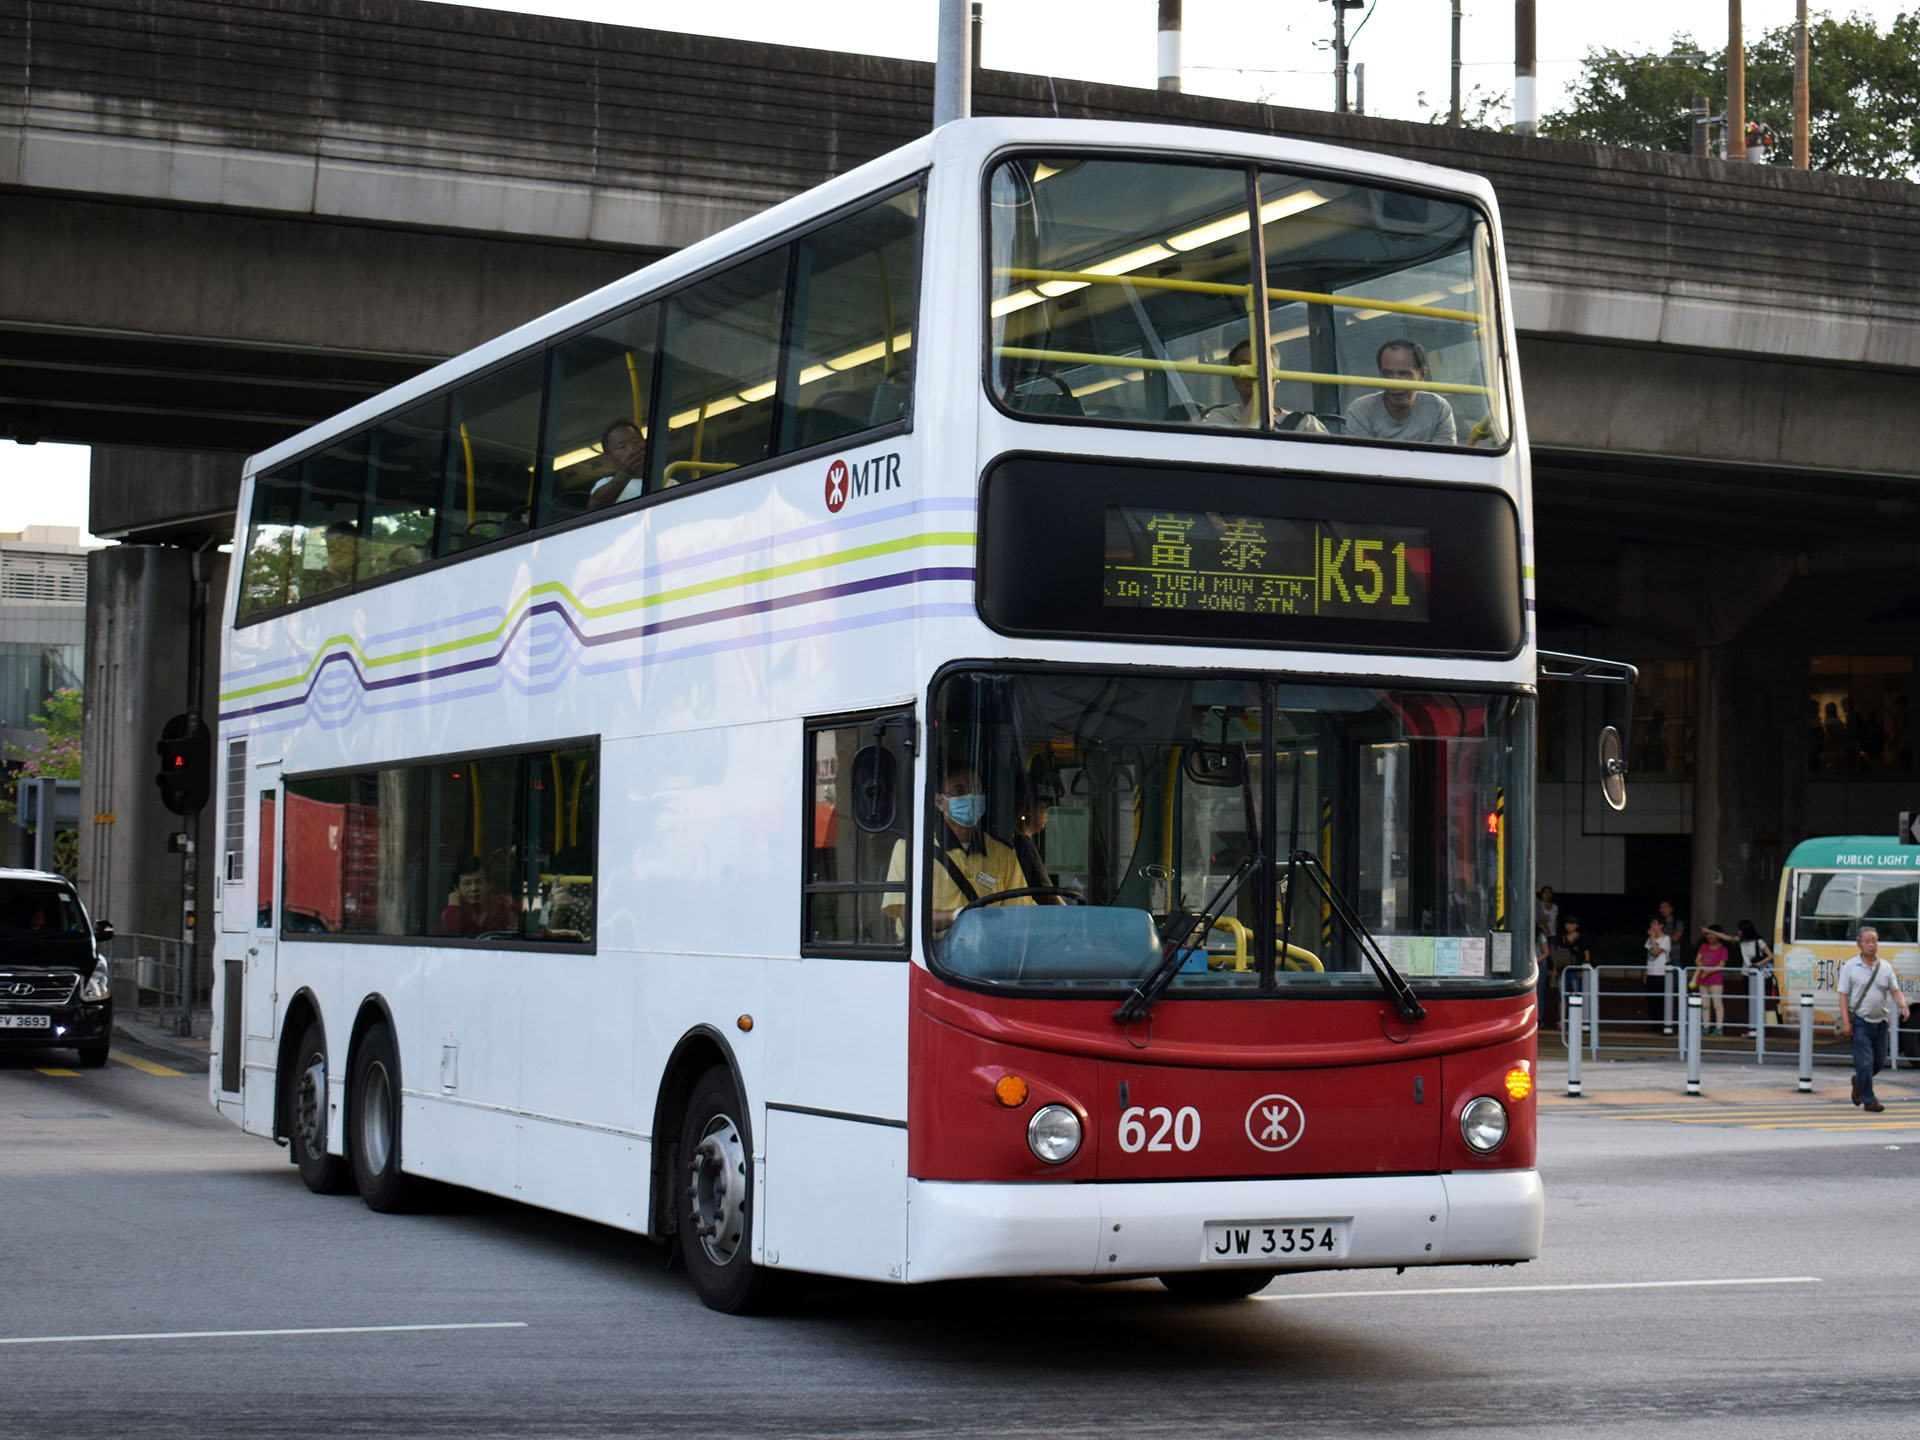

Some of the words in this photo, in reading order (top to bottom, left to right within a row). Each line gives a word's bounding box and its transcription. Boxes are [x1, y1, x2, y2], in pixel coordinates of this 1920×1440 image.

[851, 452, 901, 499] MTR
[1152, 573, 1205, 592] TUEN
[1213, 577, 1254, 594] MUN
[1322, 538, 1410, 606] K51
[1151, 591, 1187, 608] SIU
[1836, 854, 1874, 865] PUBLIC
[1877, 854, 1909, 866] LIGHT
[16, 1016, 48, 1027] 3693
[1118, 1106, 1201, 1153] 620
[1215, 1230, 1251, 1255] JW
[1260, 1228, 1335, 1253] 3354
